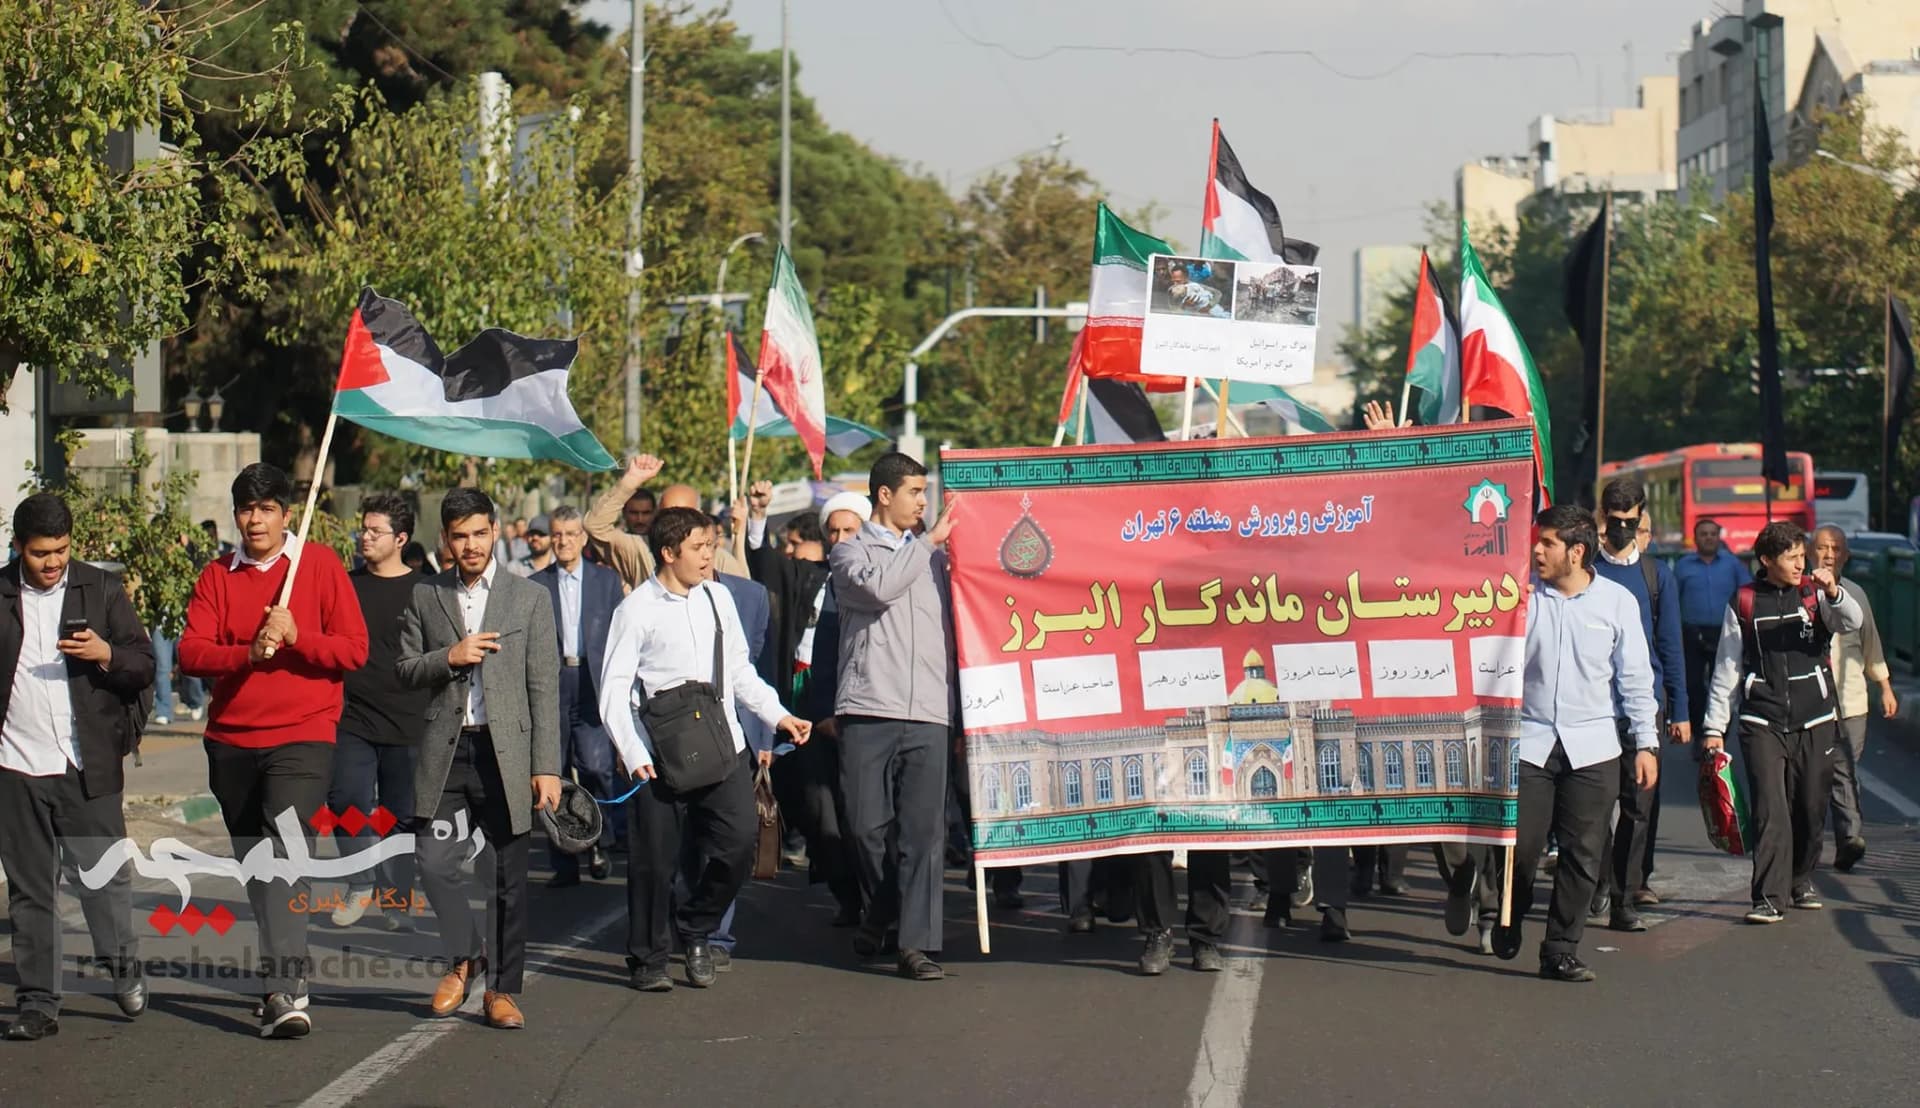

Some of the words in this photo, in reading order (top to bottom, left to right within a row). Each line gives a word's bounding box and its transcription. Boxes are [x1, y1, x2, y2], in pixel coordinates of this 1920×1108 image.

[1168, 508, 1181, 536] ۶
[1185, 506, 1231, 533] منطقه
[1238, 505, 1297, 537] پرورش
[1299, 511, 1310, 534] و
[1313, 495, 1375, 533] آموزش
[1121, 510, 1165, 542] تهران
[1134, 572, 1305, 645] ماندگار
[1316, 570, 1520, 637] دبیرستان
[1001, 580, 1122, 653] البرز
[1147, 673, 1177, 688] رهبر
[1194, 668, 1222, 682] خامنه
[1282, 665, 1315, 681] امروز
[1318, 664, 1356, 680] عزاست
[1378, 665, 1407, 681] روز
[1409, 663, 1450, 681] امروز
[1478, 659, 1516, 679] عزاست
[1041, 681, 1080, 696] عزاست
[1082, 676, 1115, 693] صاحب
[963, 688, 1005, 711] امروز
